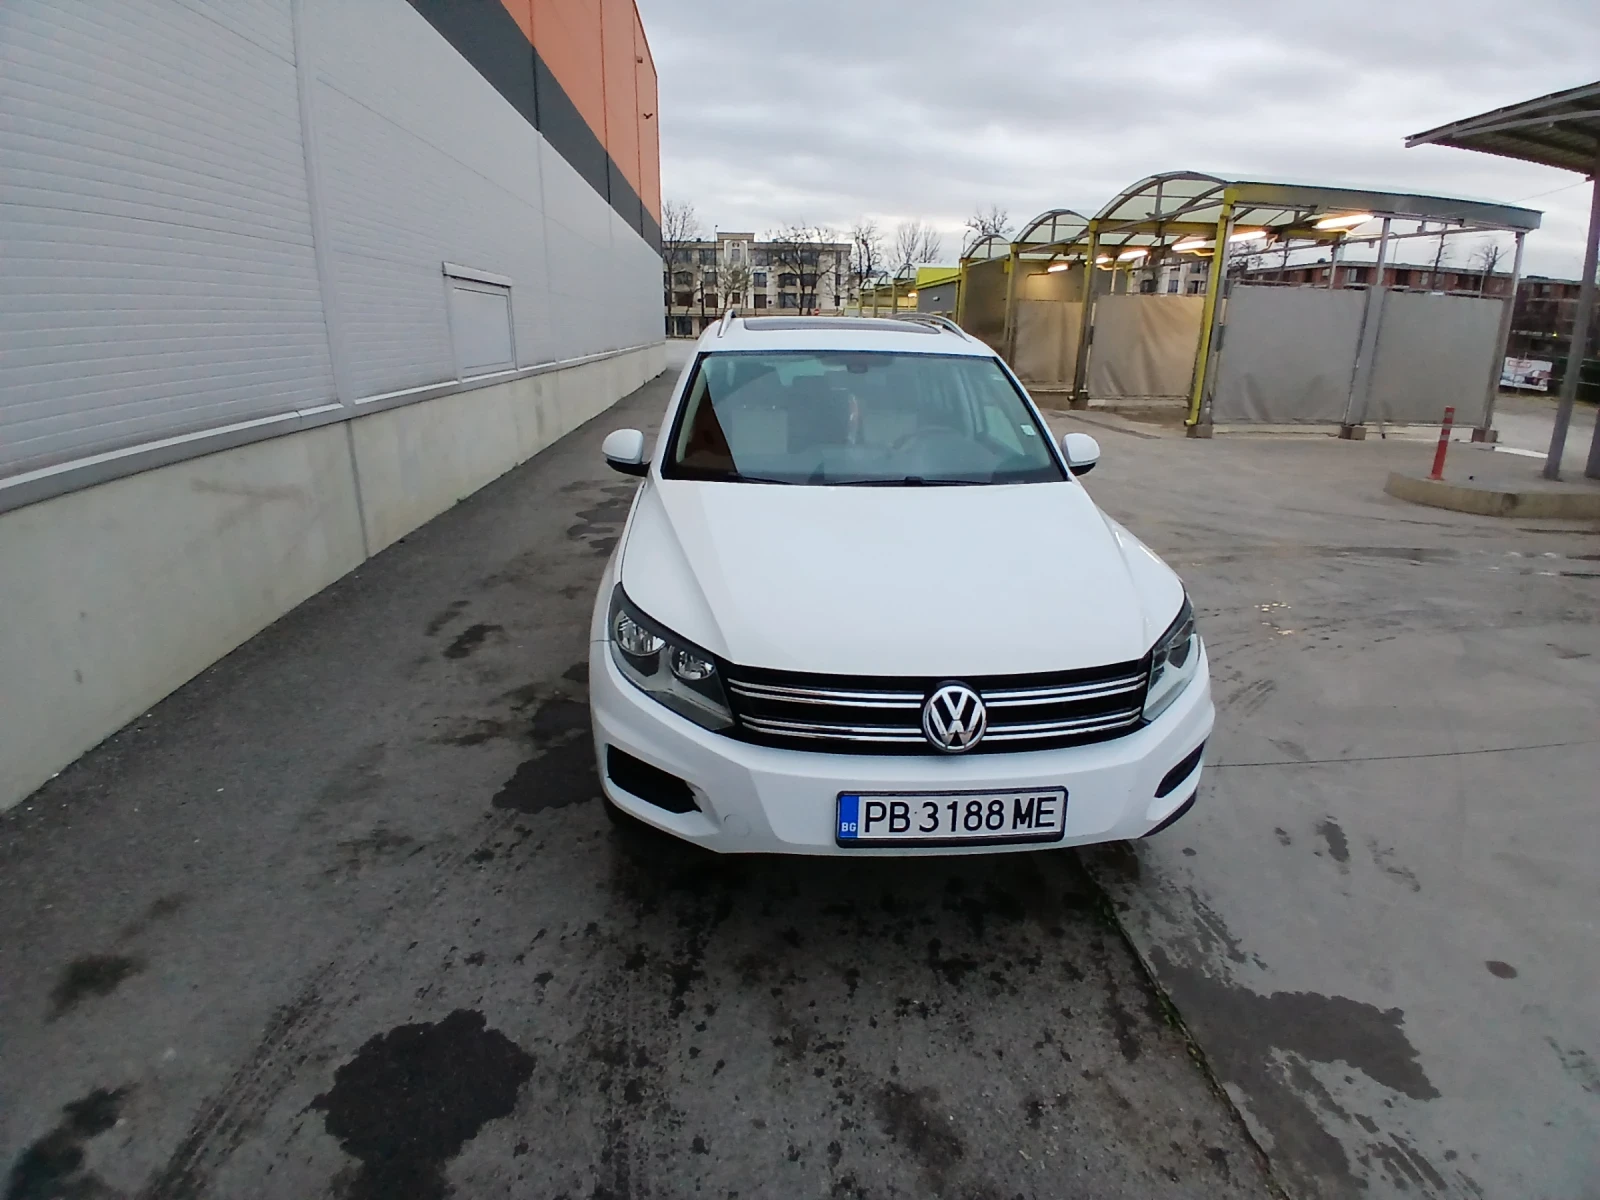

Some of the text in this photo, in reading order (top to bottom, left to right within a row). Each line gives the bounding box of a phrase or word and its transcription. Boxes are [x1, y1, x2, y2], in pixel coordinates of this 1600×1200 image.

[926, 688, 985, 749] VW
[841, 822, 857, 833] BG
[864, 796, 1057, 833] PB 3188 ME
